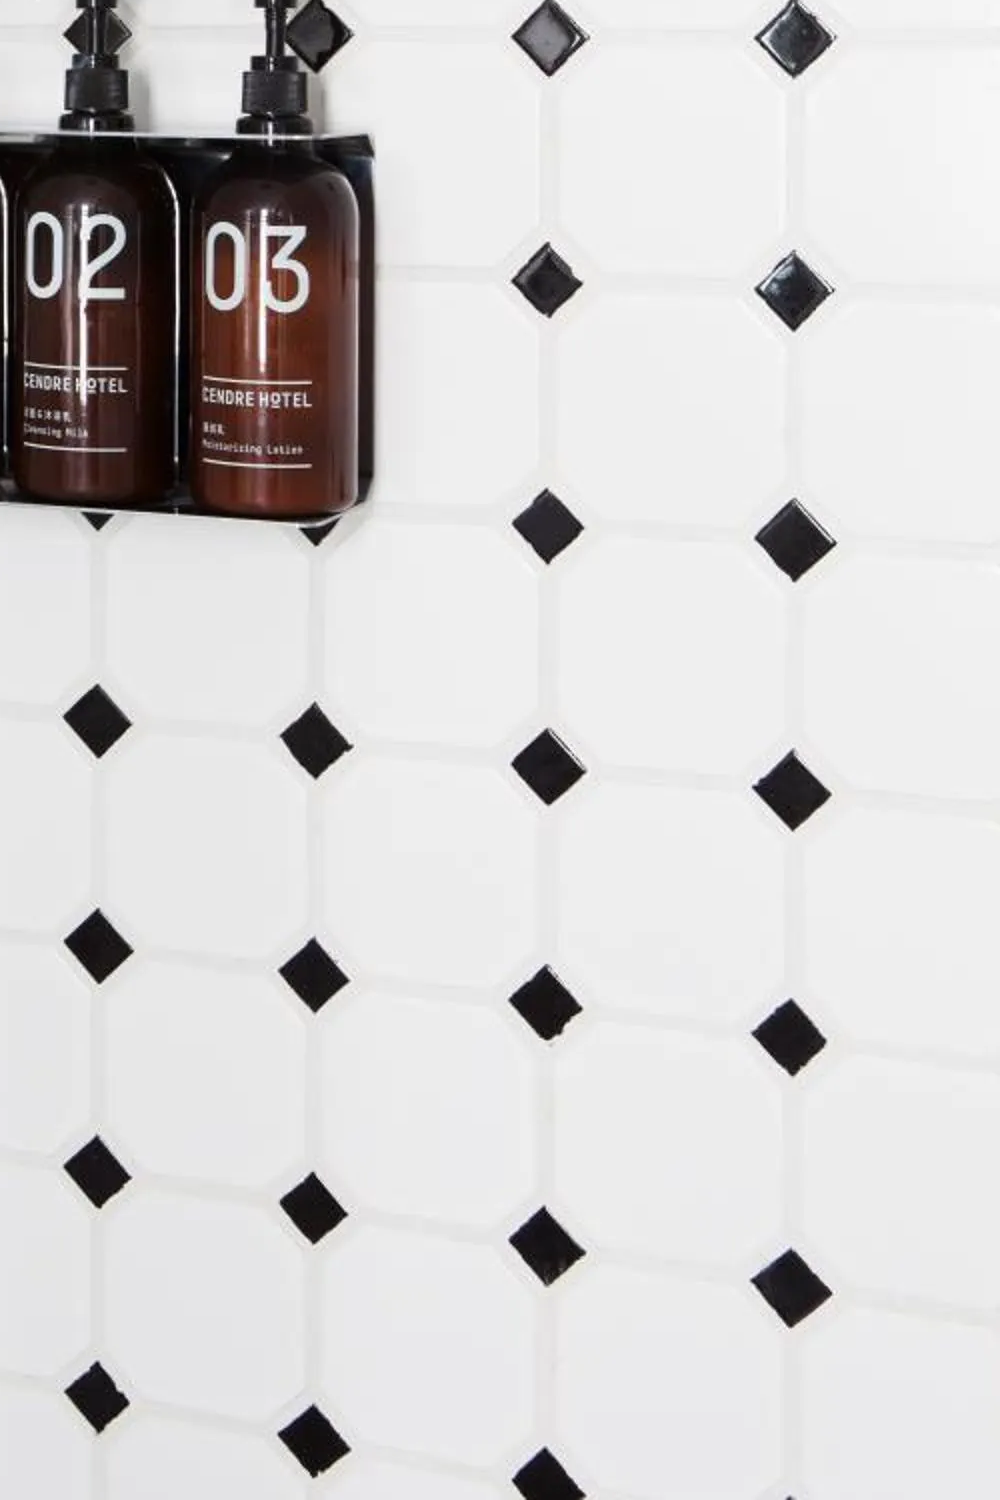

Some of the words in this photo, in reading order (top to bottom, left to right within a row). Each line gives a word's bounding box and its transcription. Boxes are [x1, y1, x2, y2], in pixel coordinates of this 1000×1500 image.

[25, 211, 128, 300] 02
[205, 221, 311, 313] 03
[24, 372, 72, 393] CENDRE
[202, 386, 256, 408] CENDRE
[259, 391, 313, 409] HOTEL
